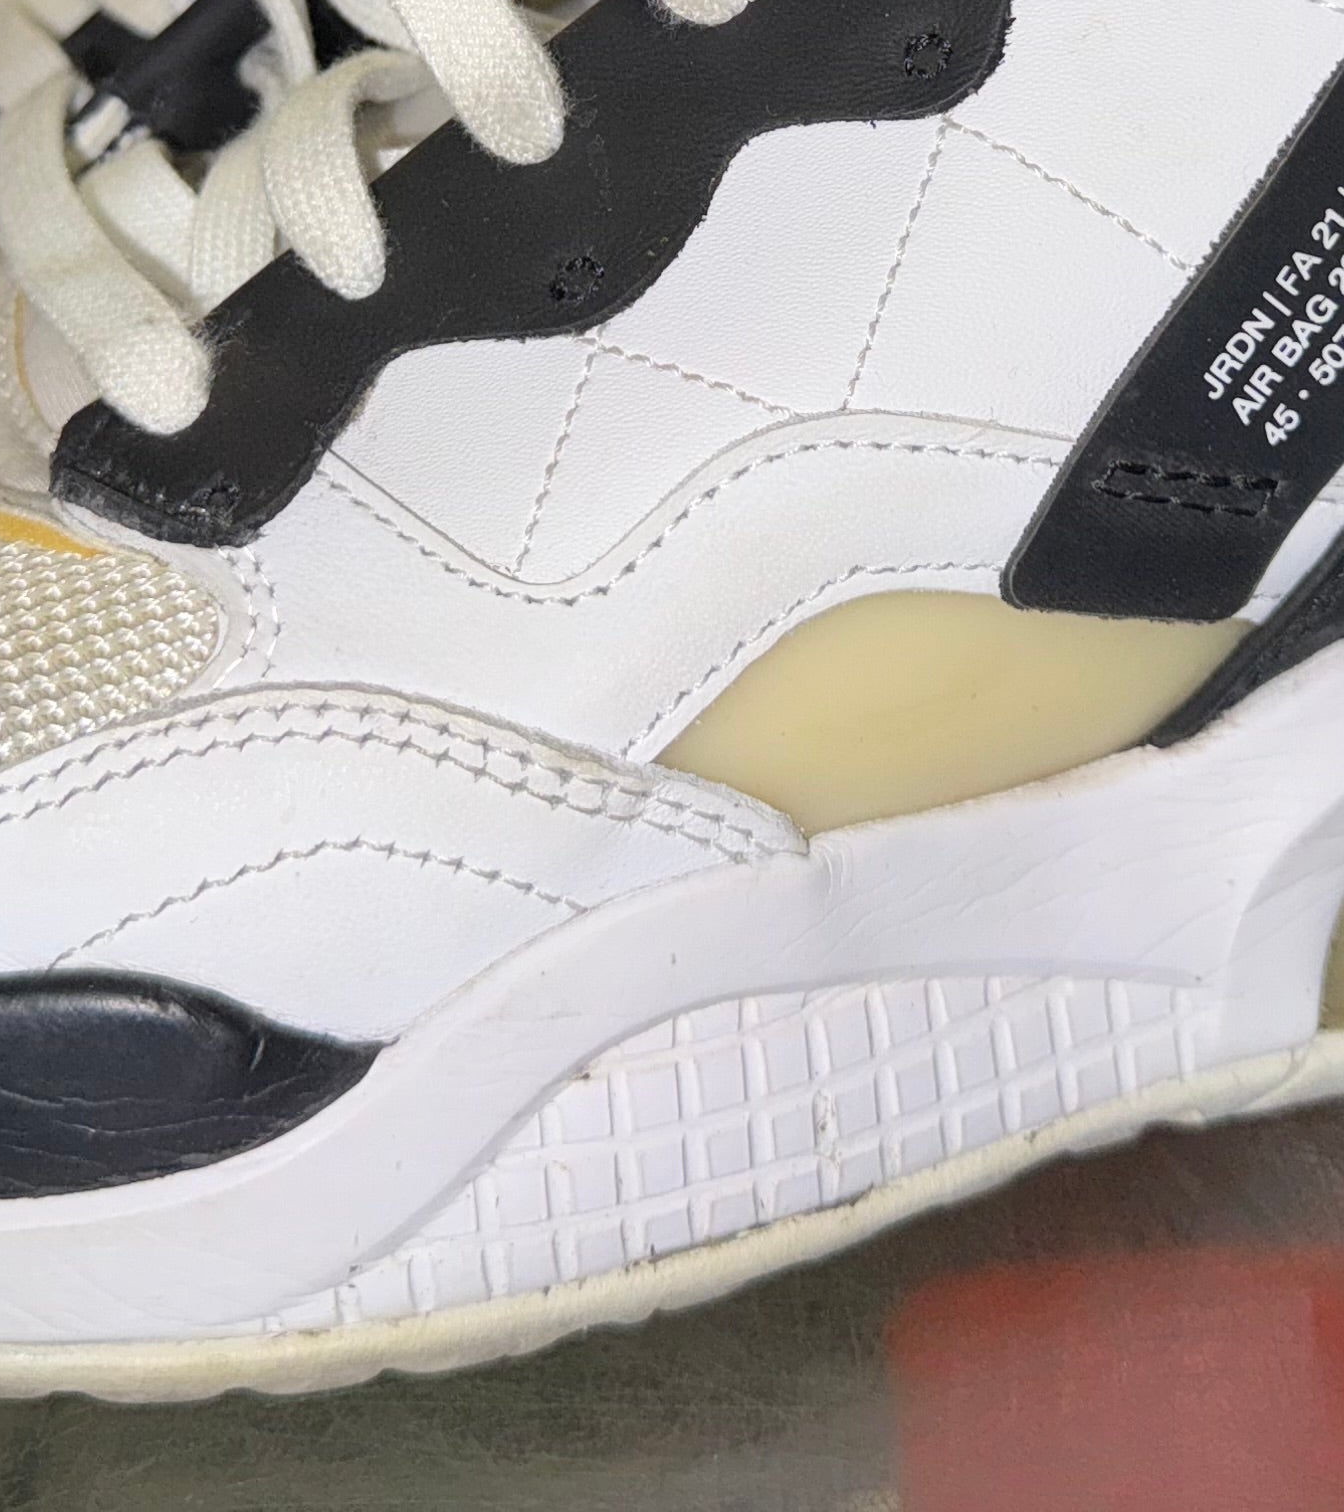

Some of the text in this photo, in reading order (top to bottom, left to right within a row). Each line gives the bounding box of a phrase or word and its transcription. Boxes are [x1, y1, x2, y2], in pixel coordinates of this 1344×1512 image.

[1203, 307, 1276, 400] JRDN
[1275, 251, 1323, 296] FA
[1232, 364, 1284, 426] AIR
[1271, 294, 1339, 368] BAG
[1264, 402, 1300, 446] 45
